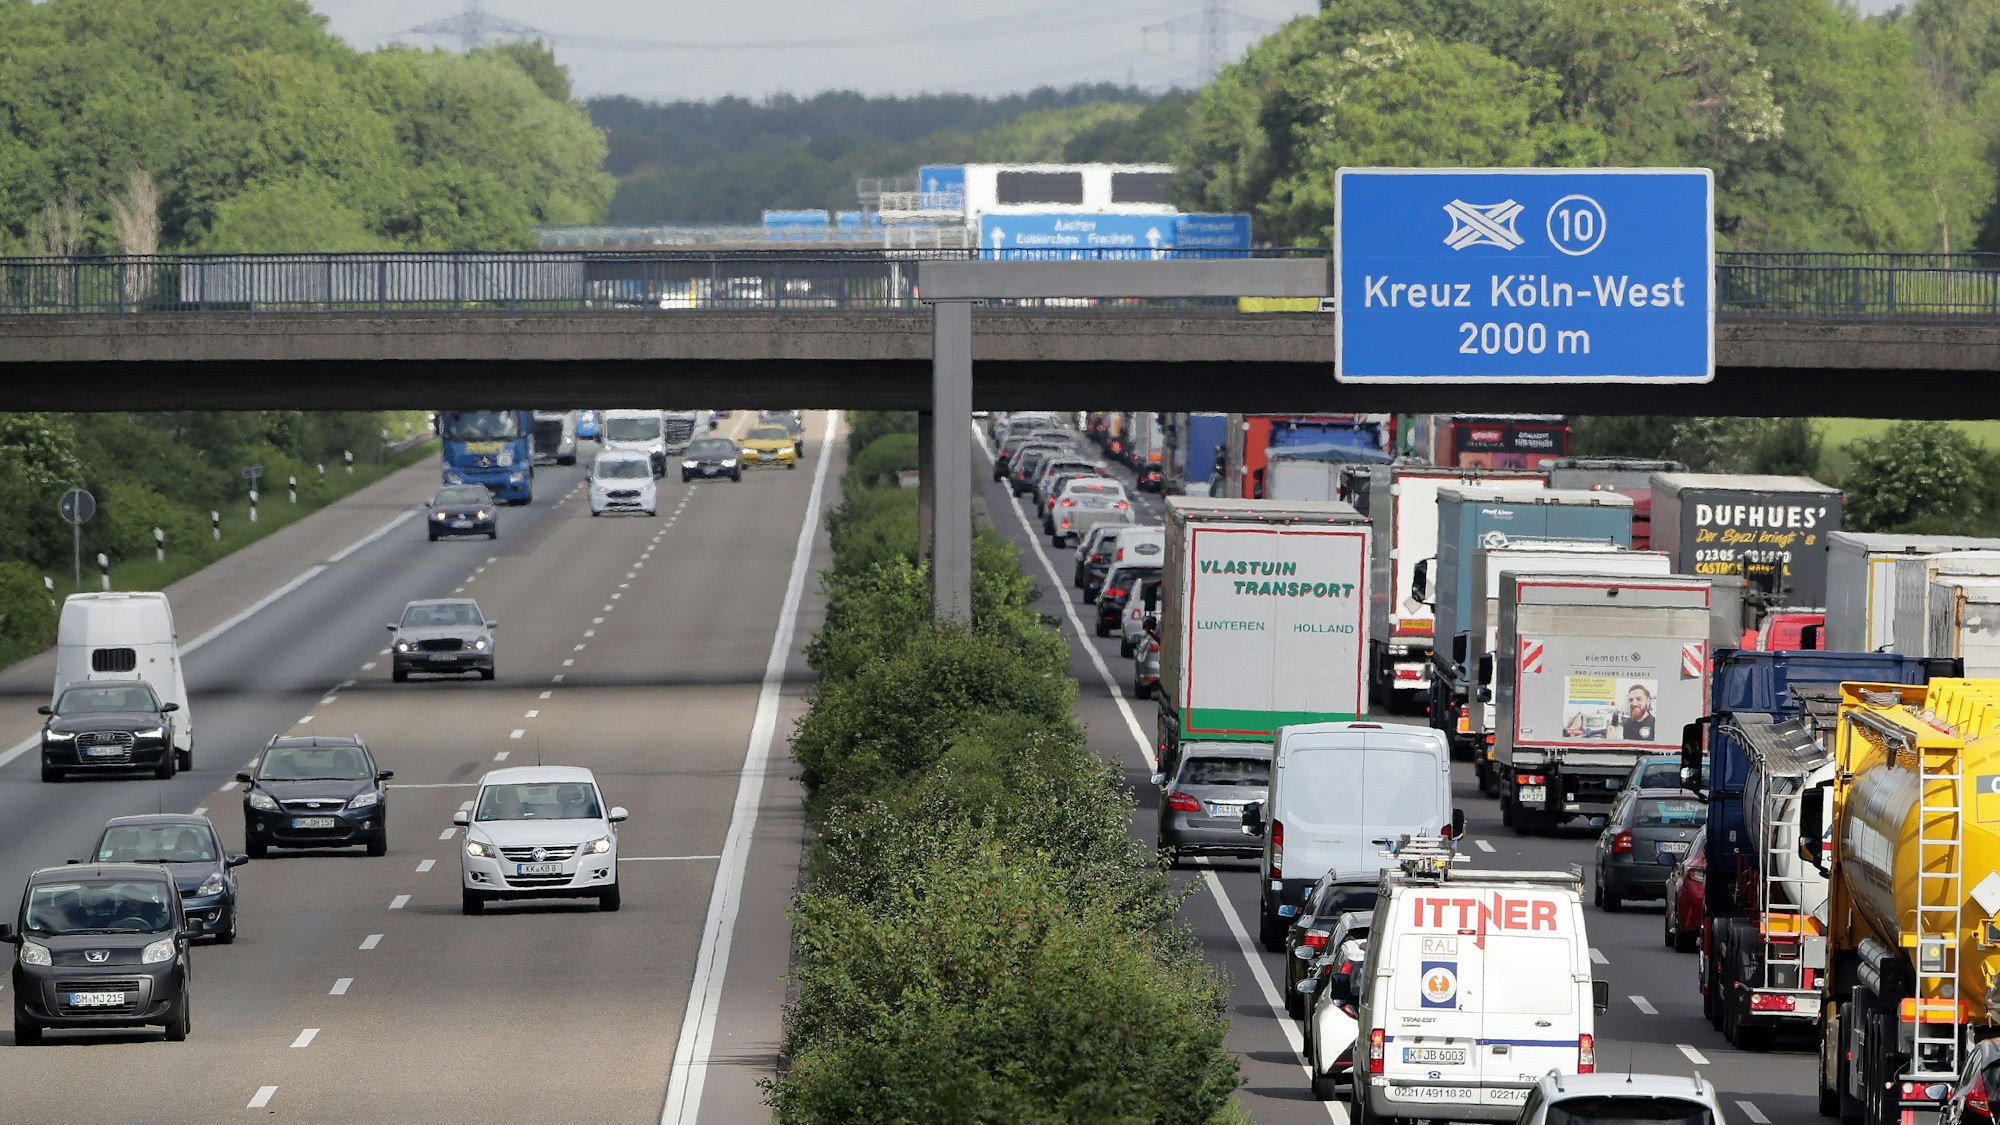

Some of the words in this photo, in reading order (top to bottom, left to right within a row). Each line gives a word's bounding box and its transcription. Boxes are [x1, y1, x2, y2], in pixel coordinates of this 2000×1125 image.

[1559, 208, 1594, 242] 10
[1364, 275, 1471, 307] Kreuz
[1491, 274, 1685, 307] Köln-West
[1459, 322, 1547, 354] 2000
[1558, 330, 1590, 354] m
[1696, 528, 1718, 542] Der
[1200, 560, 1297, 576] VLASTUIN
[1234, 580, 1354, 599] TRANSPORT
[1197, 621, 1265, 631] LUNTEREN
[1293, 623, 1354, 634] HOLLAND
[1585, 653, 1628, 662] elements
[1414, 891, 1557, 950] ITTNER
[1424, 939, 1455, 953] RAL
[76, 994, 88, 1003] BM
[106, 994, 123, 1003] 215
[1410, 1051, 1416, 1060] K
[1424, 1050, 1437, 1060] JB
[1439, 1051, 1464, 1061] 6003
[1519, 1073, 1537, 1081] Fax
[1490, 1090, 1530, 1100] 0221/4
